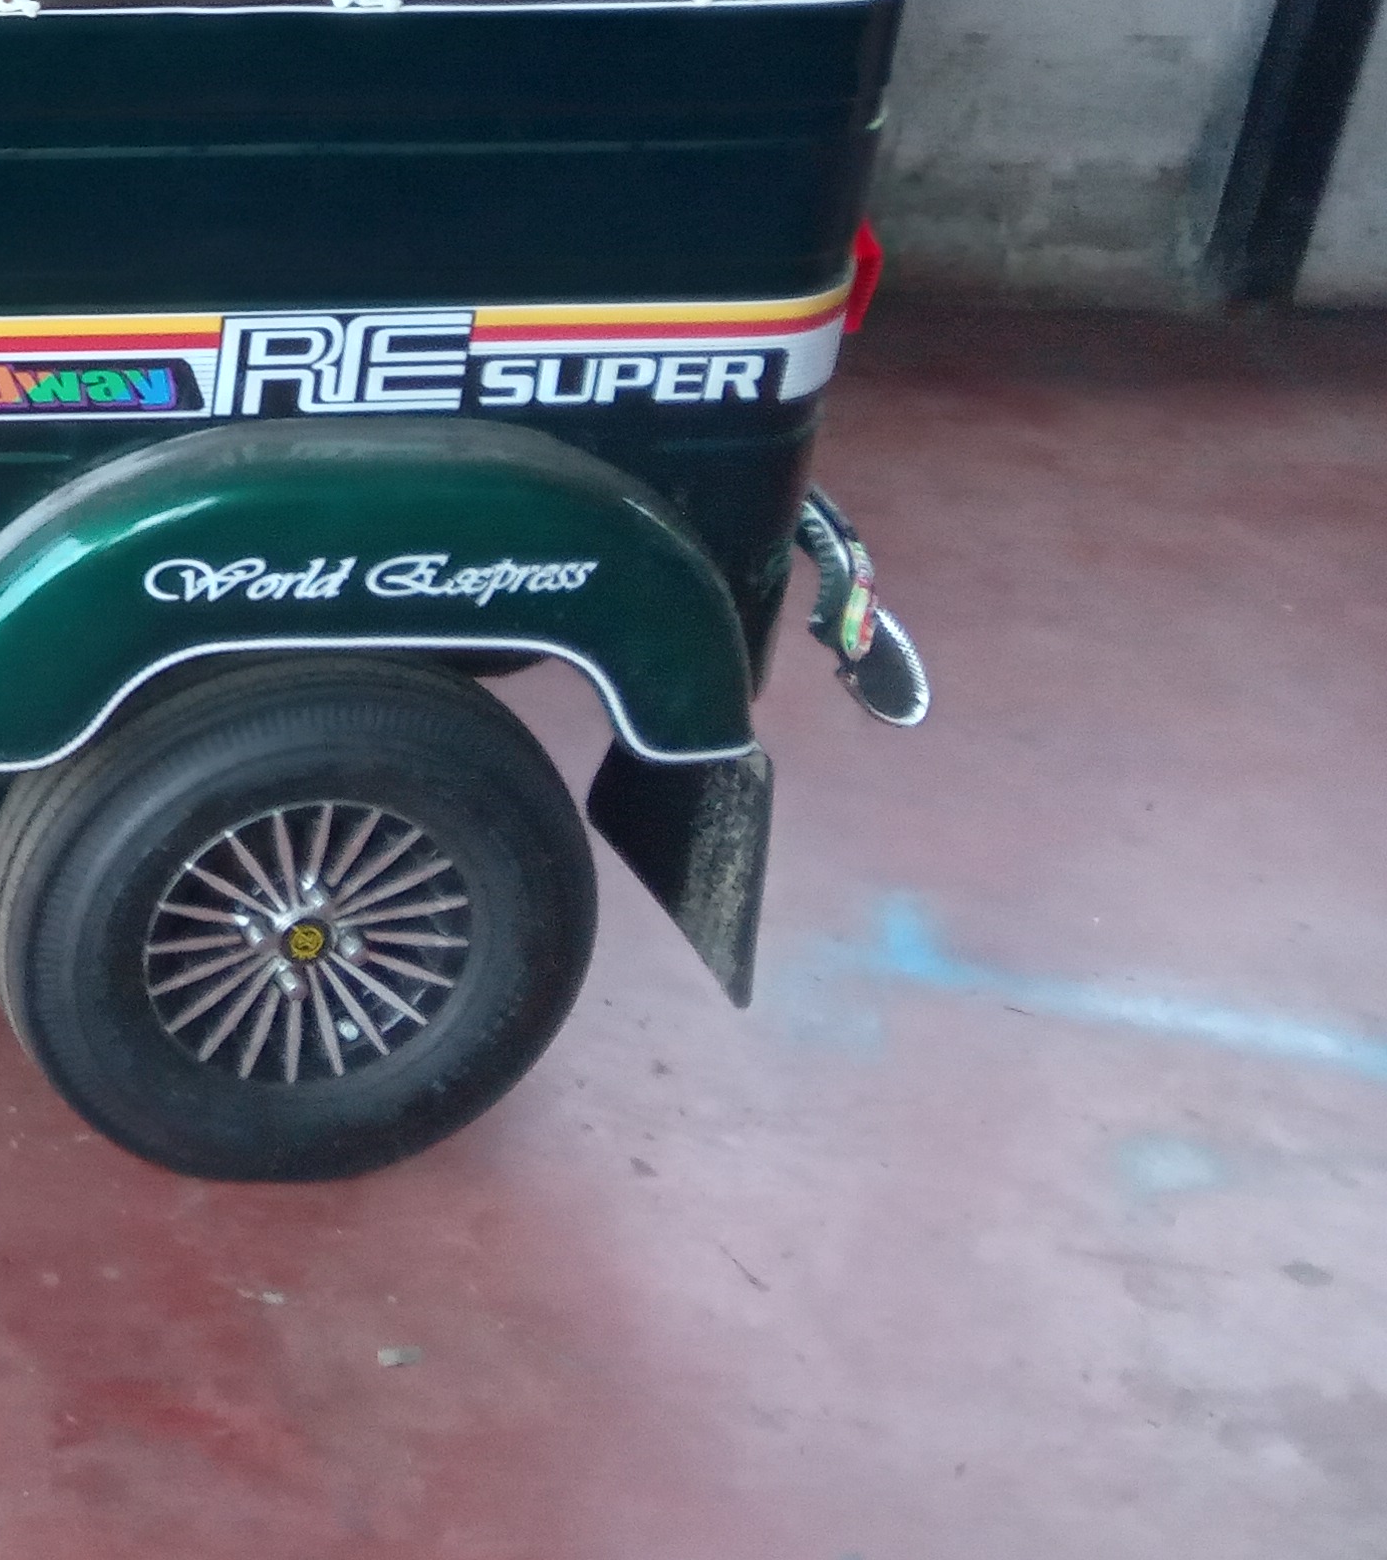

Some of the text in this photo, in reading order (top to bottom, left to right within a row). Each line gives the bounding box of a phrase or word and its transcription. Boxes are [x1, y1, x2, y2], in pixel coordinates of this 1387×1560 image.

[211, 312, 766, 417] RE SUPER
[143, 552, 600, 607] World Express
